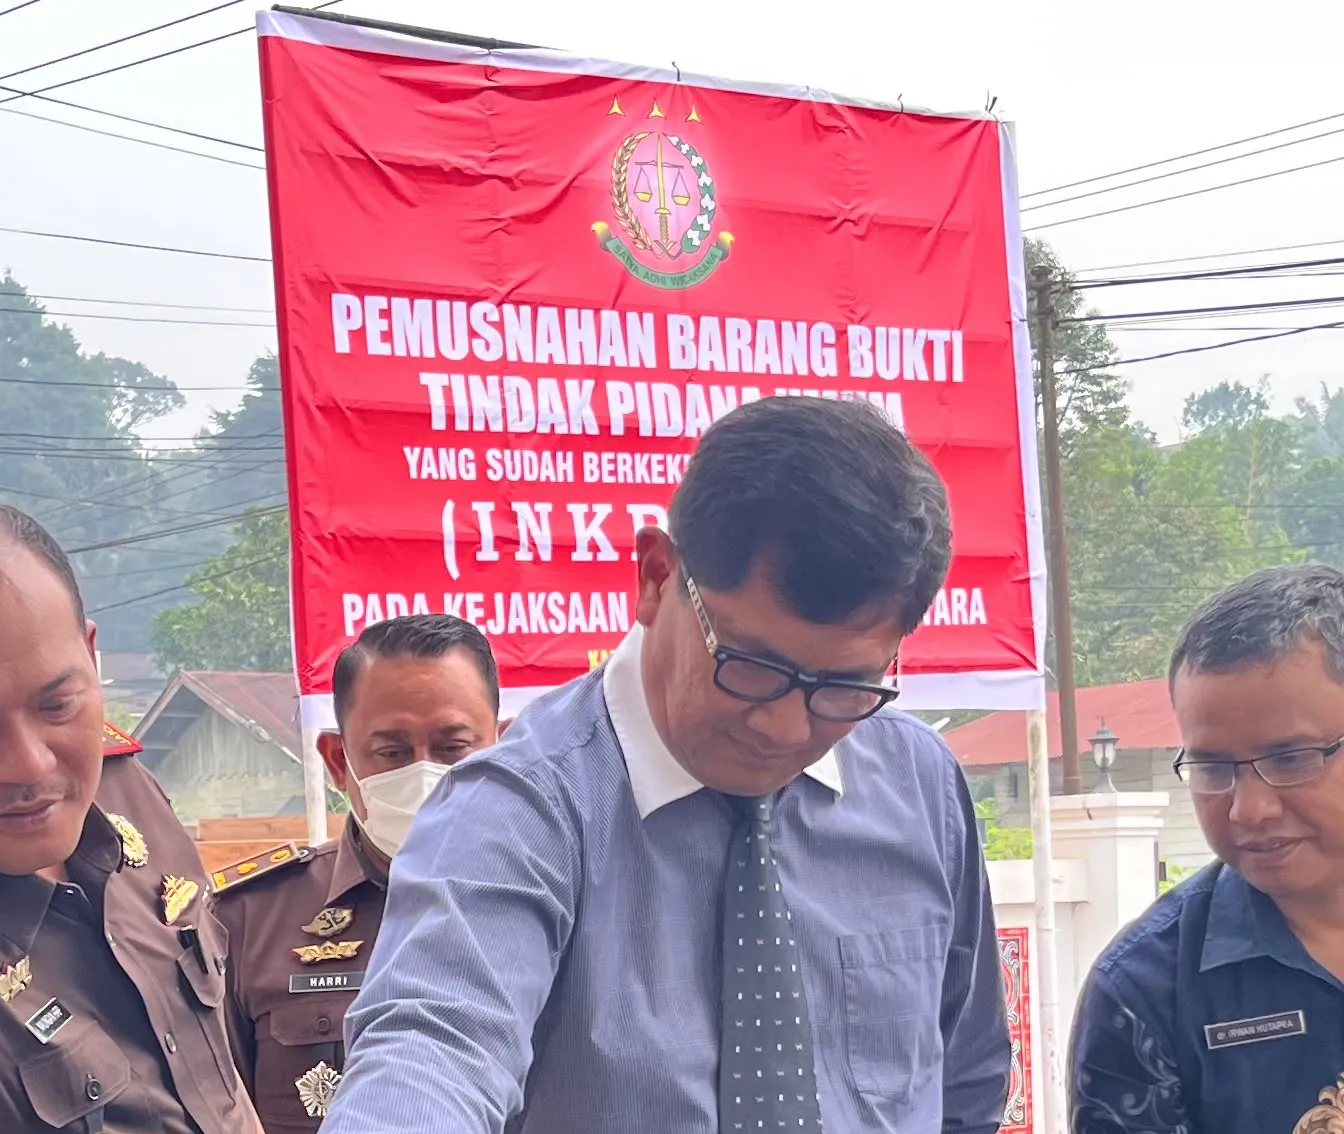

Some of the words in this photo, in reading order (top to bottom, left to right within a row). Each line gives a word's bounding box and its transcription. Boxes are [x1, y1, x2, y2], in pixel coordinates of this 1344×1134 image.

[644, 273, 667, 287] ADHI
[331, 293, 656, 368] PEMUSNAHAN
[667, 314, 838, 376] BARANG
[847, 324, 963, 382] BUKTI
[419, 372, 599, 435] TINDAK
[606, 381, 761, 437] PIDAN
[403, 447, 476, 480] YANG
[486, 449, 574, 482] SUDAH
[583, 452, 692, 485] BERKEK
[443, 591, 629, 635] KEJAKSAAN
[923, 588, 987, 626] ARA
[309, 976, 348, 987] HARRI
